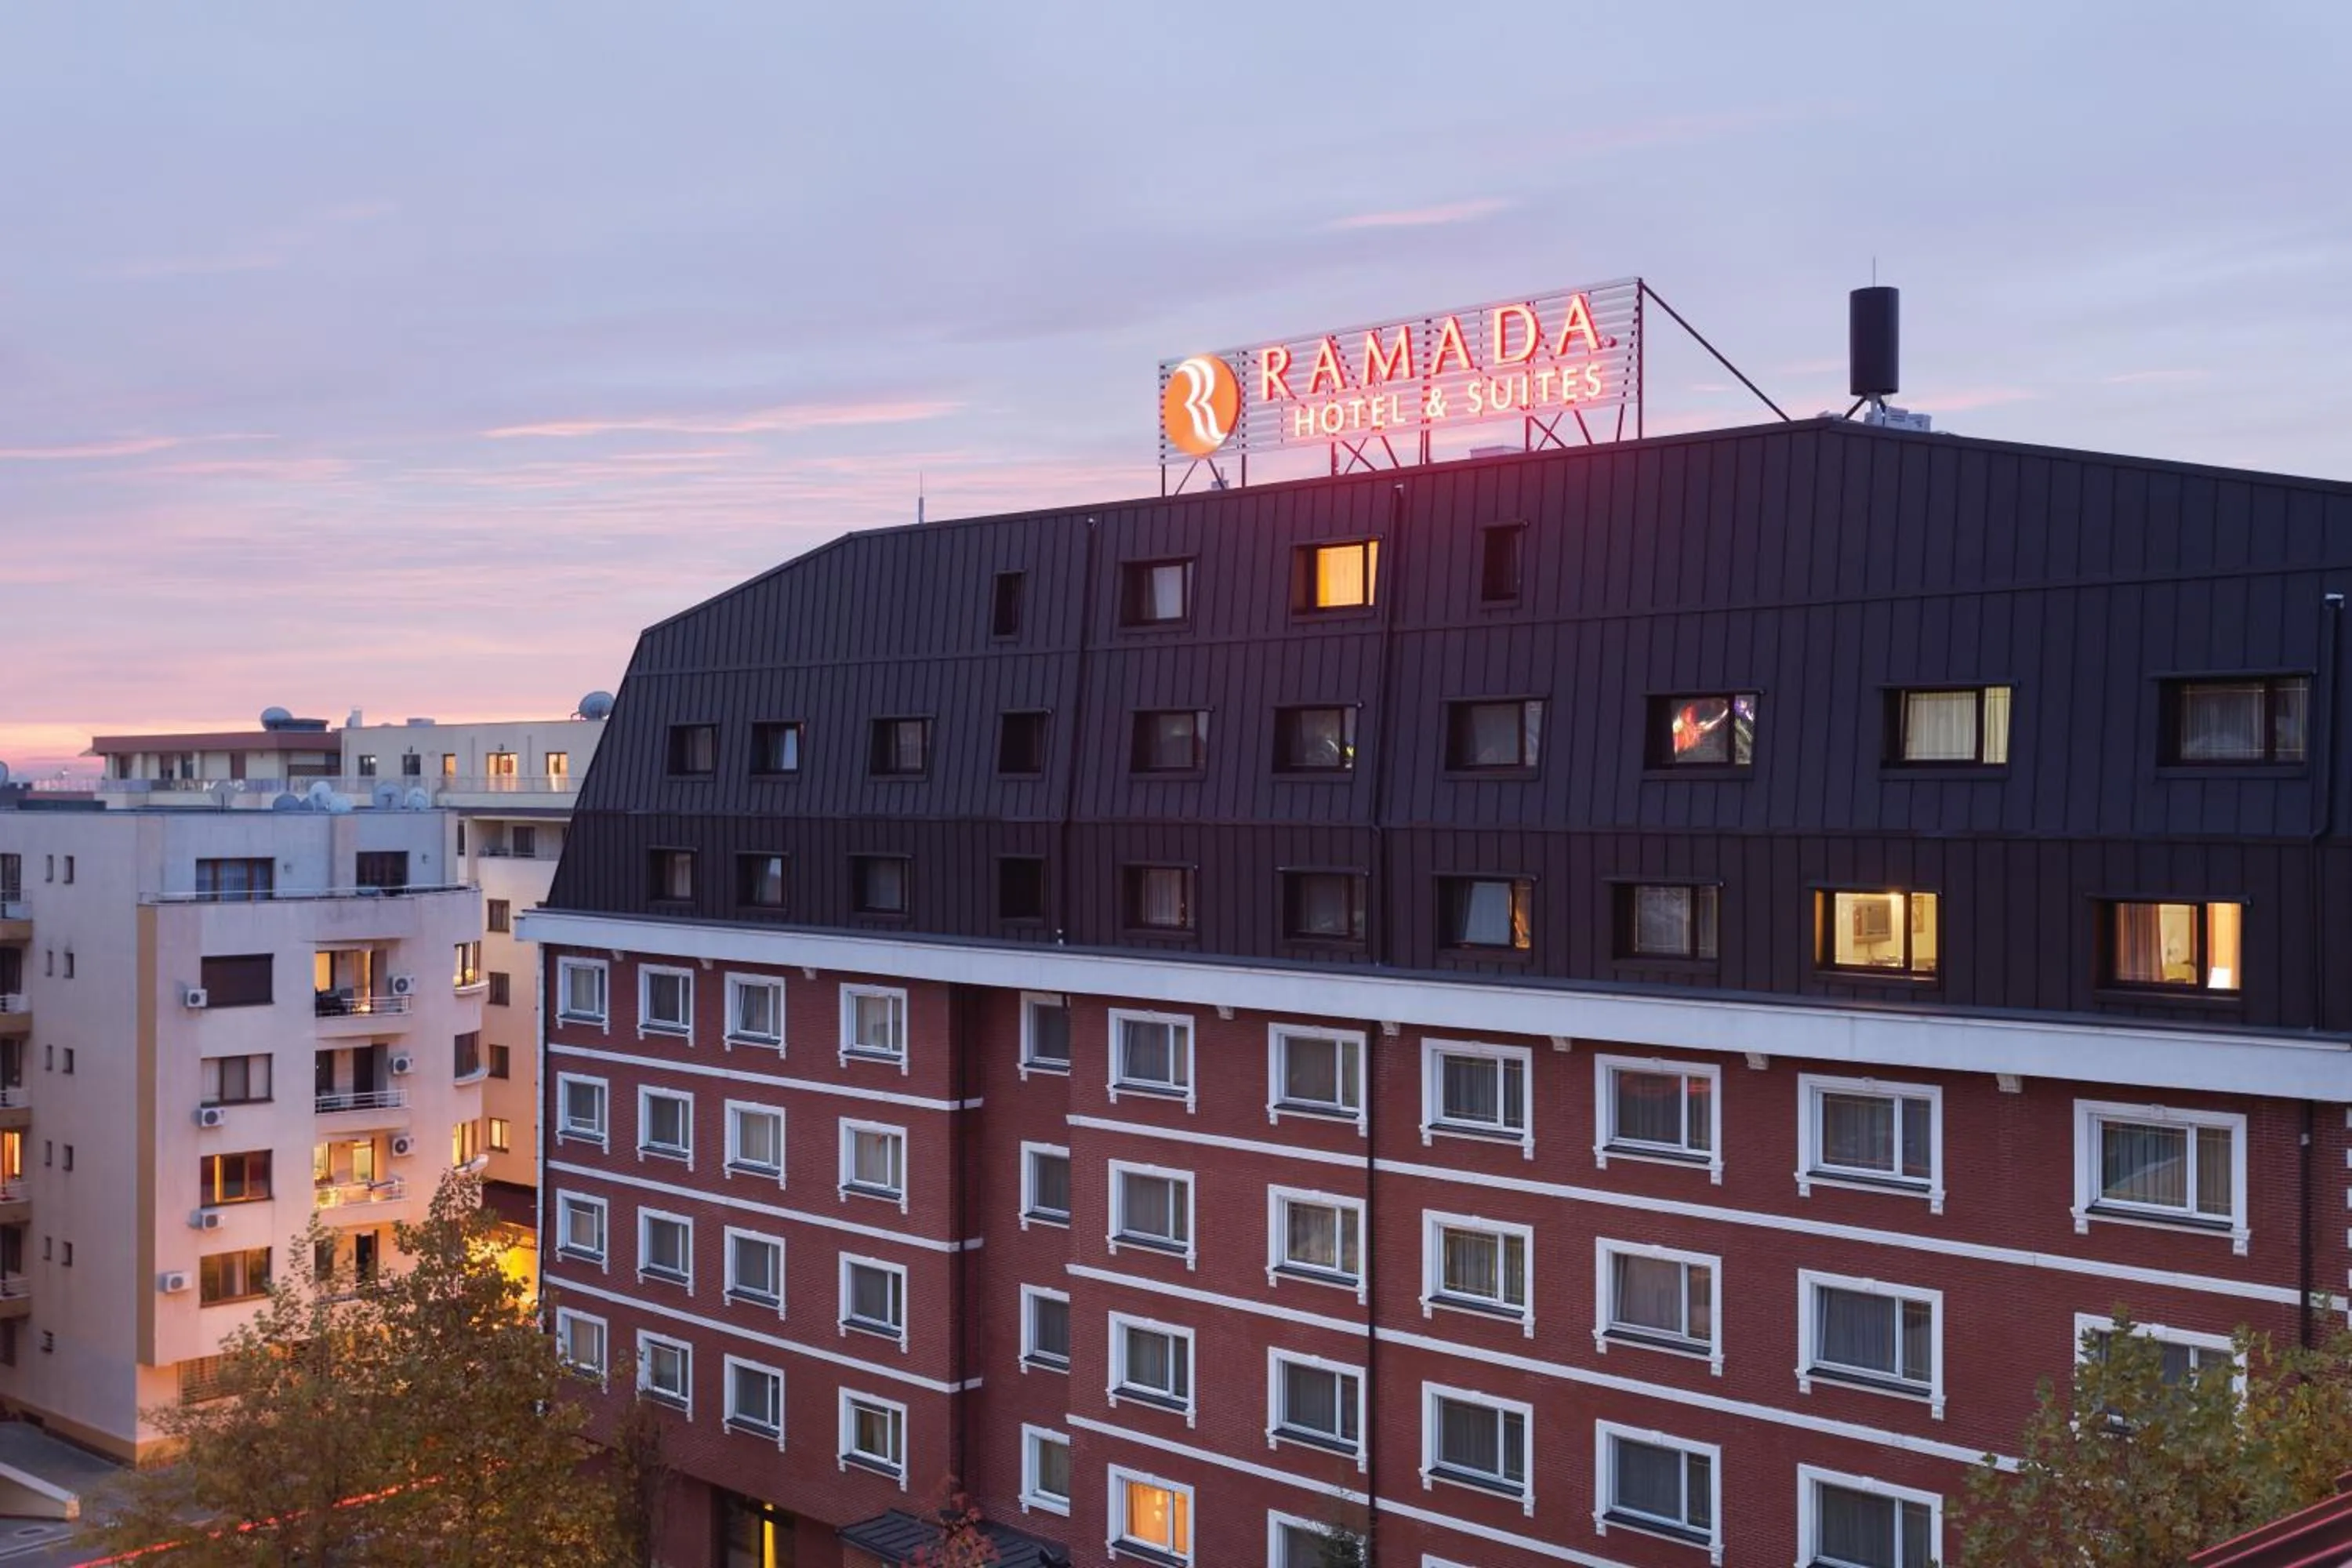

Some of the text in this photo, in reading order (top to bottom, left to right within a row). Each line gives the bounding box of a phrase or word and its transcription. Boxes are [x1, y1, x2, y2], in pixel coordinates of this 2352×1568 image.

[1261, 292, 1602, 401] RAMADA
[1295, 364, 1602, 437] HOTEL & SUITES
